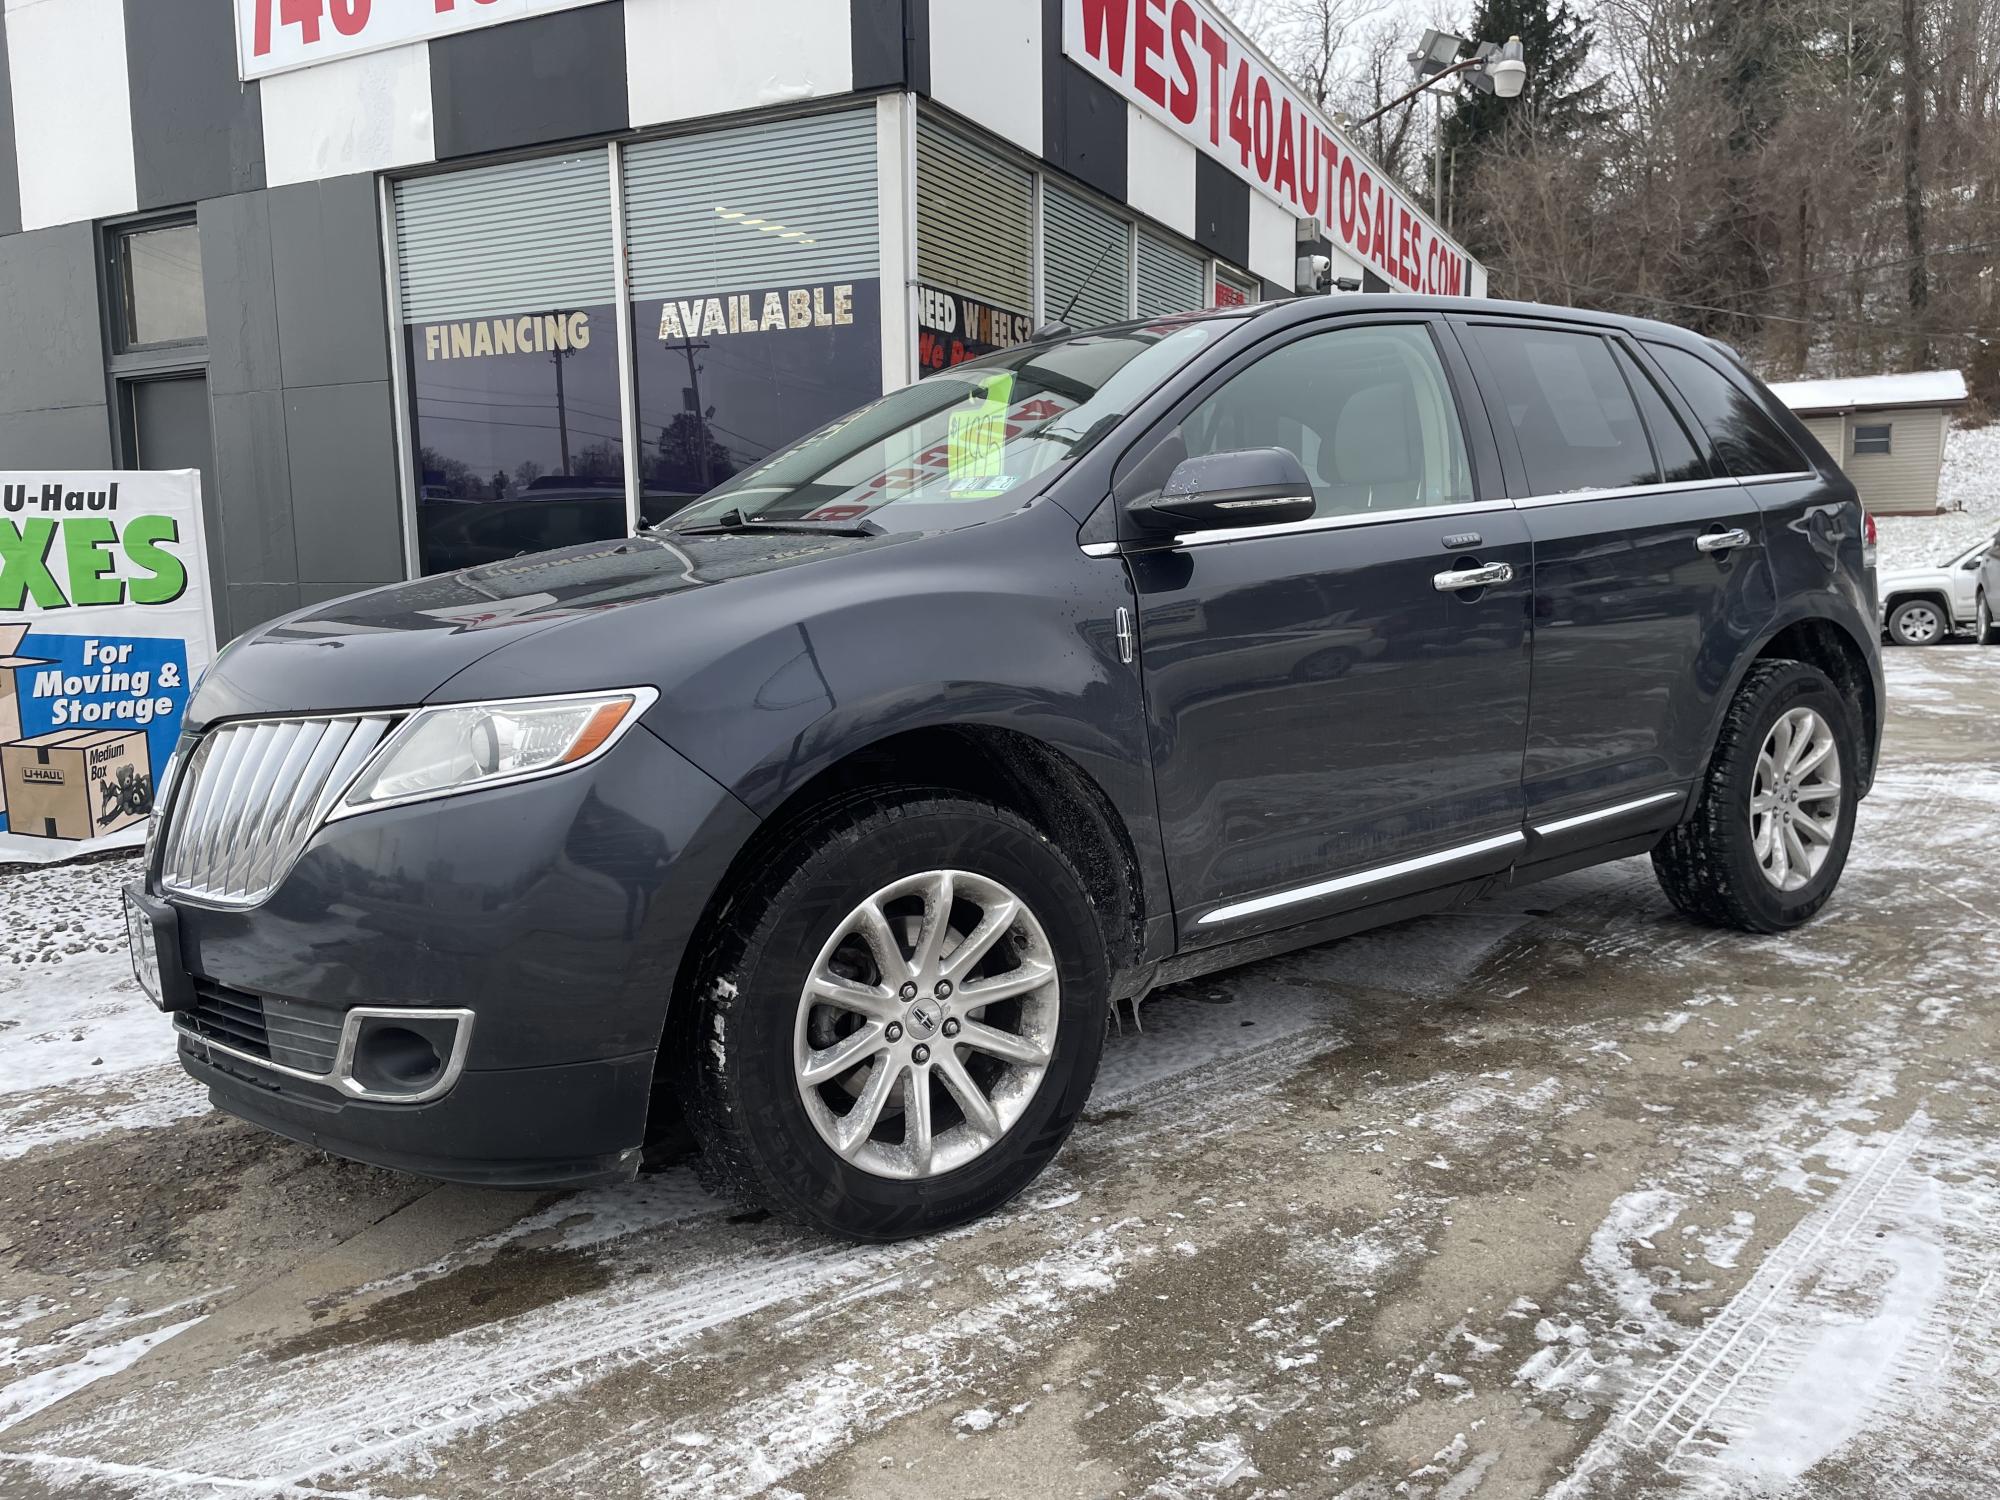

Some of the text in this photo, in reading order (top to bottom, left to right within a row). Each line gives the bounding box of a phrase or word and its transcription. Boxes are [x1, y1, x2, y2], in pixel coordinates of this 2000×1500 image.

[425, 284, 854, 361] FINANCING AVAILABLE
[918, 285, 1032, 348] NEED WHEELS?
[919, 332, 944, 368] We
[3, 482, 119, 512] U-Haul
[83, 639, 133, 666] For
[32, 662, 182, 697] Moving &
[51, 696, 173, 724] Storage
[90, 744, 125, 766] Medium
[24, 769, 63, 781] U-HAUL
[91, 765, 108, 781] Box
